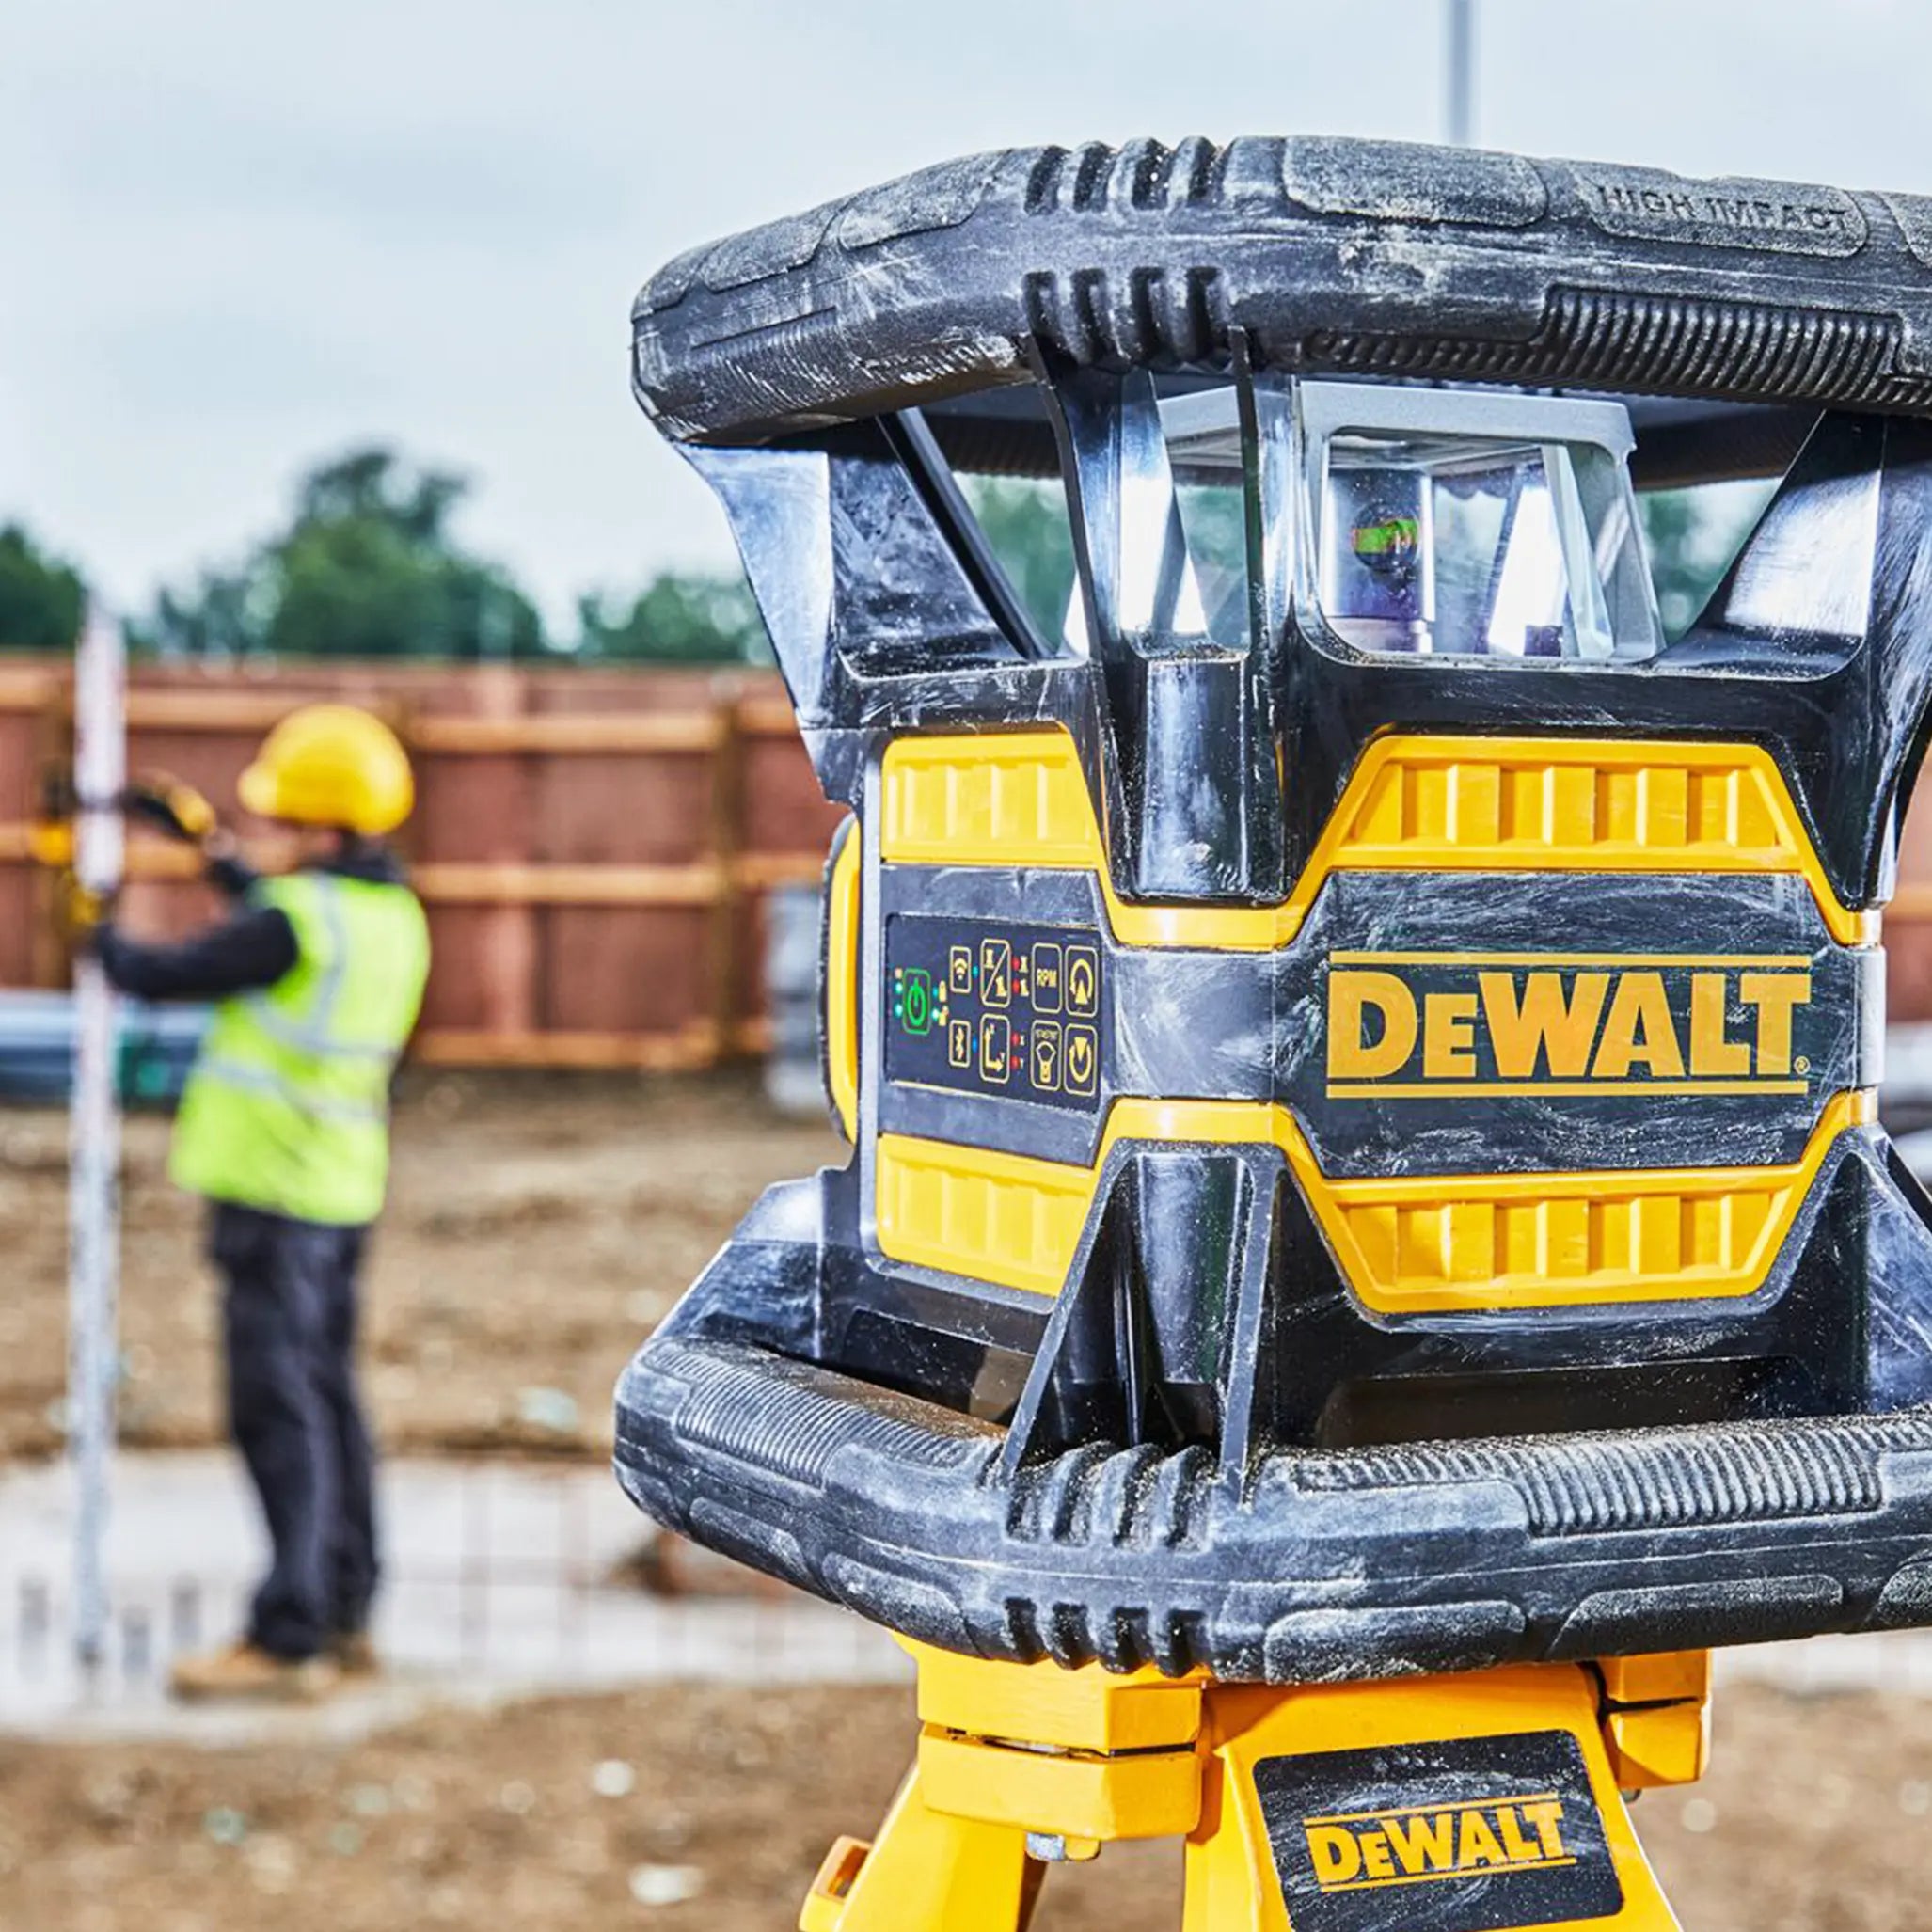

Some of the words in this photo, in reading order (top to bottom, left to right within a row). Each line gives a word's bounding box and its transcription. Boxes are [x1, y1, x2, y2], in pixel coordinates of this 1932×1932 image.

[1596, 185, 1695, 218] HIGH
[1703, 197, 1847, 231] IMPACT
[1036, 968, 1057, 988] RPM
